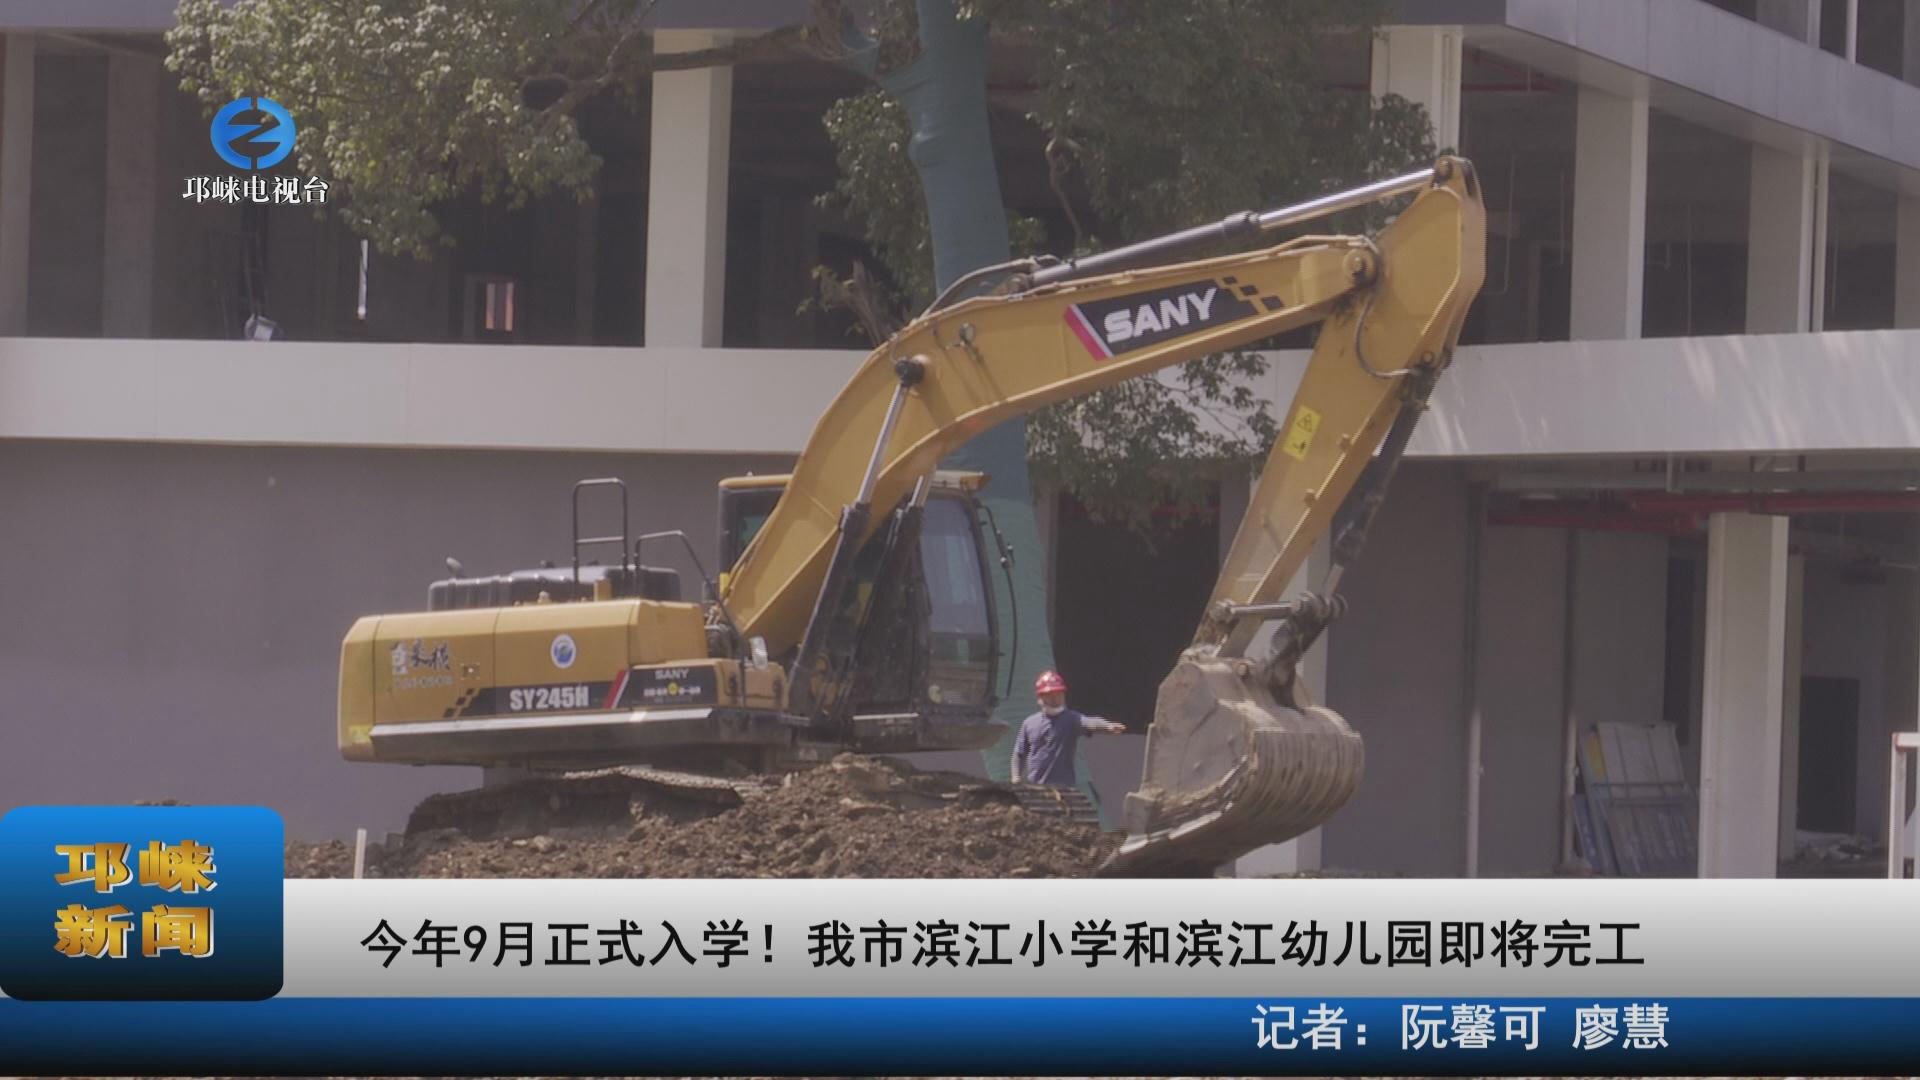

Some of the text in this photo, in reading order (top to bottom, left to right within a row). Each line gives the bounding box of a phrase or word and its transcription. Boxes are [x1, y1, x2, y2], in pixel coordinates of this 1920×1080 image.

[1104, 287, 1217, 343] SANY
[655, 668, 690, 680] SANY
[509, 686, 589, 710] SY245H
